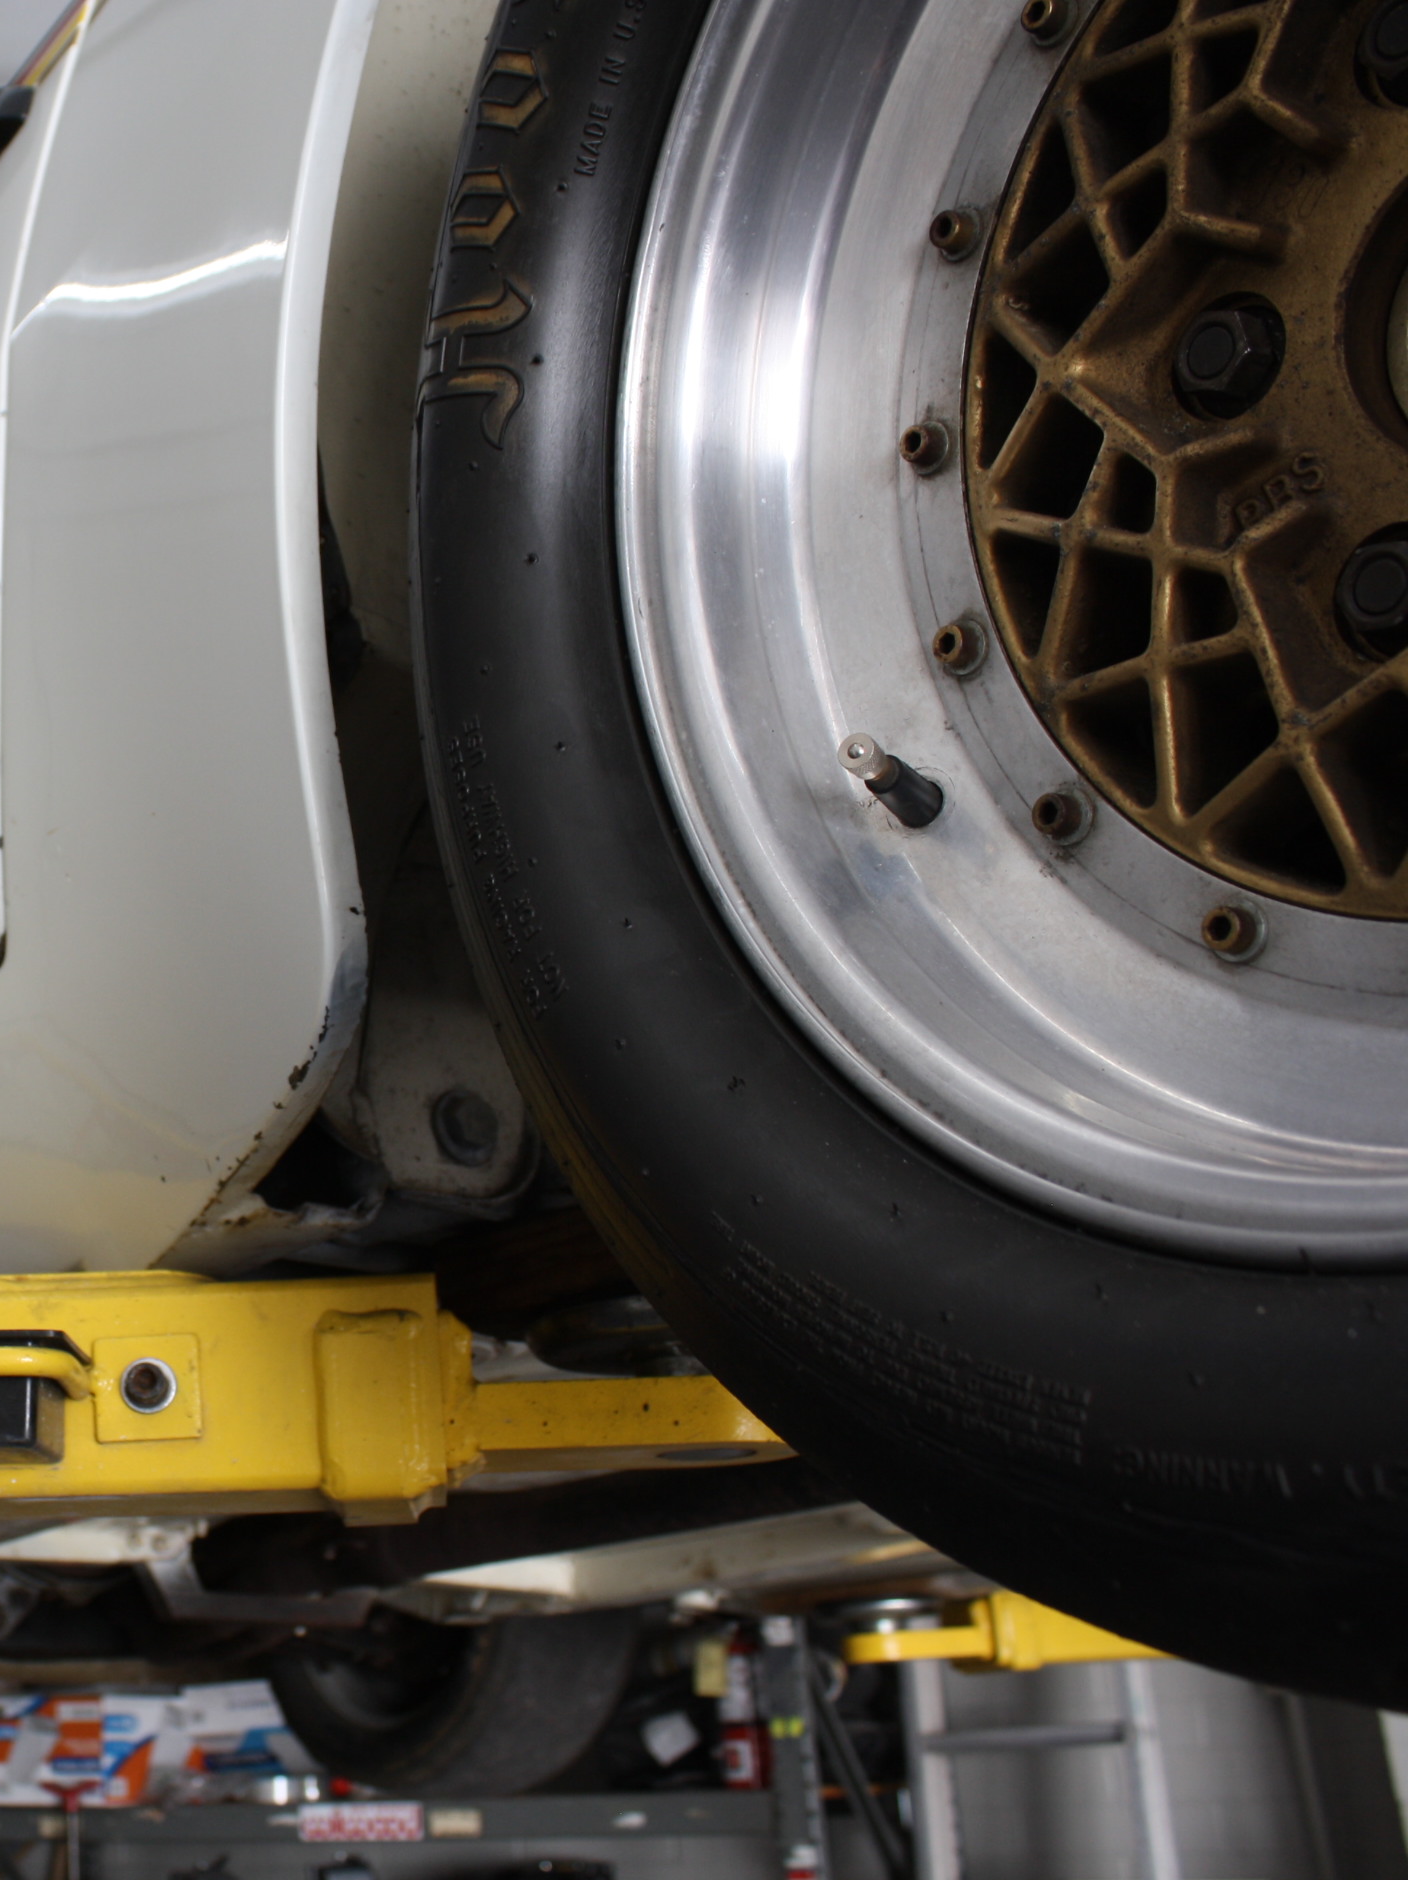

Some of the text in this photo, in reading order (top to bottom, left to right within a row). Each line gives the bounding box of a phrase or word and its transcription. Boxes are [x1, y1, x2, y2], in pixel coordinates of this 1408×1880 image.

[574, 103, 612, 177] MADE
[600, 55, 627, 87] IN
[447, 736, 550, 1021] FOR RACING PURPOSES
[461, 712, 572, 1002] NOT FOR HIGHWAY USE
